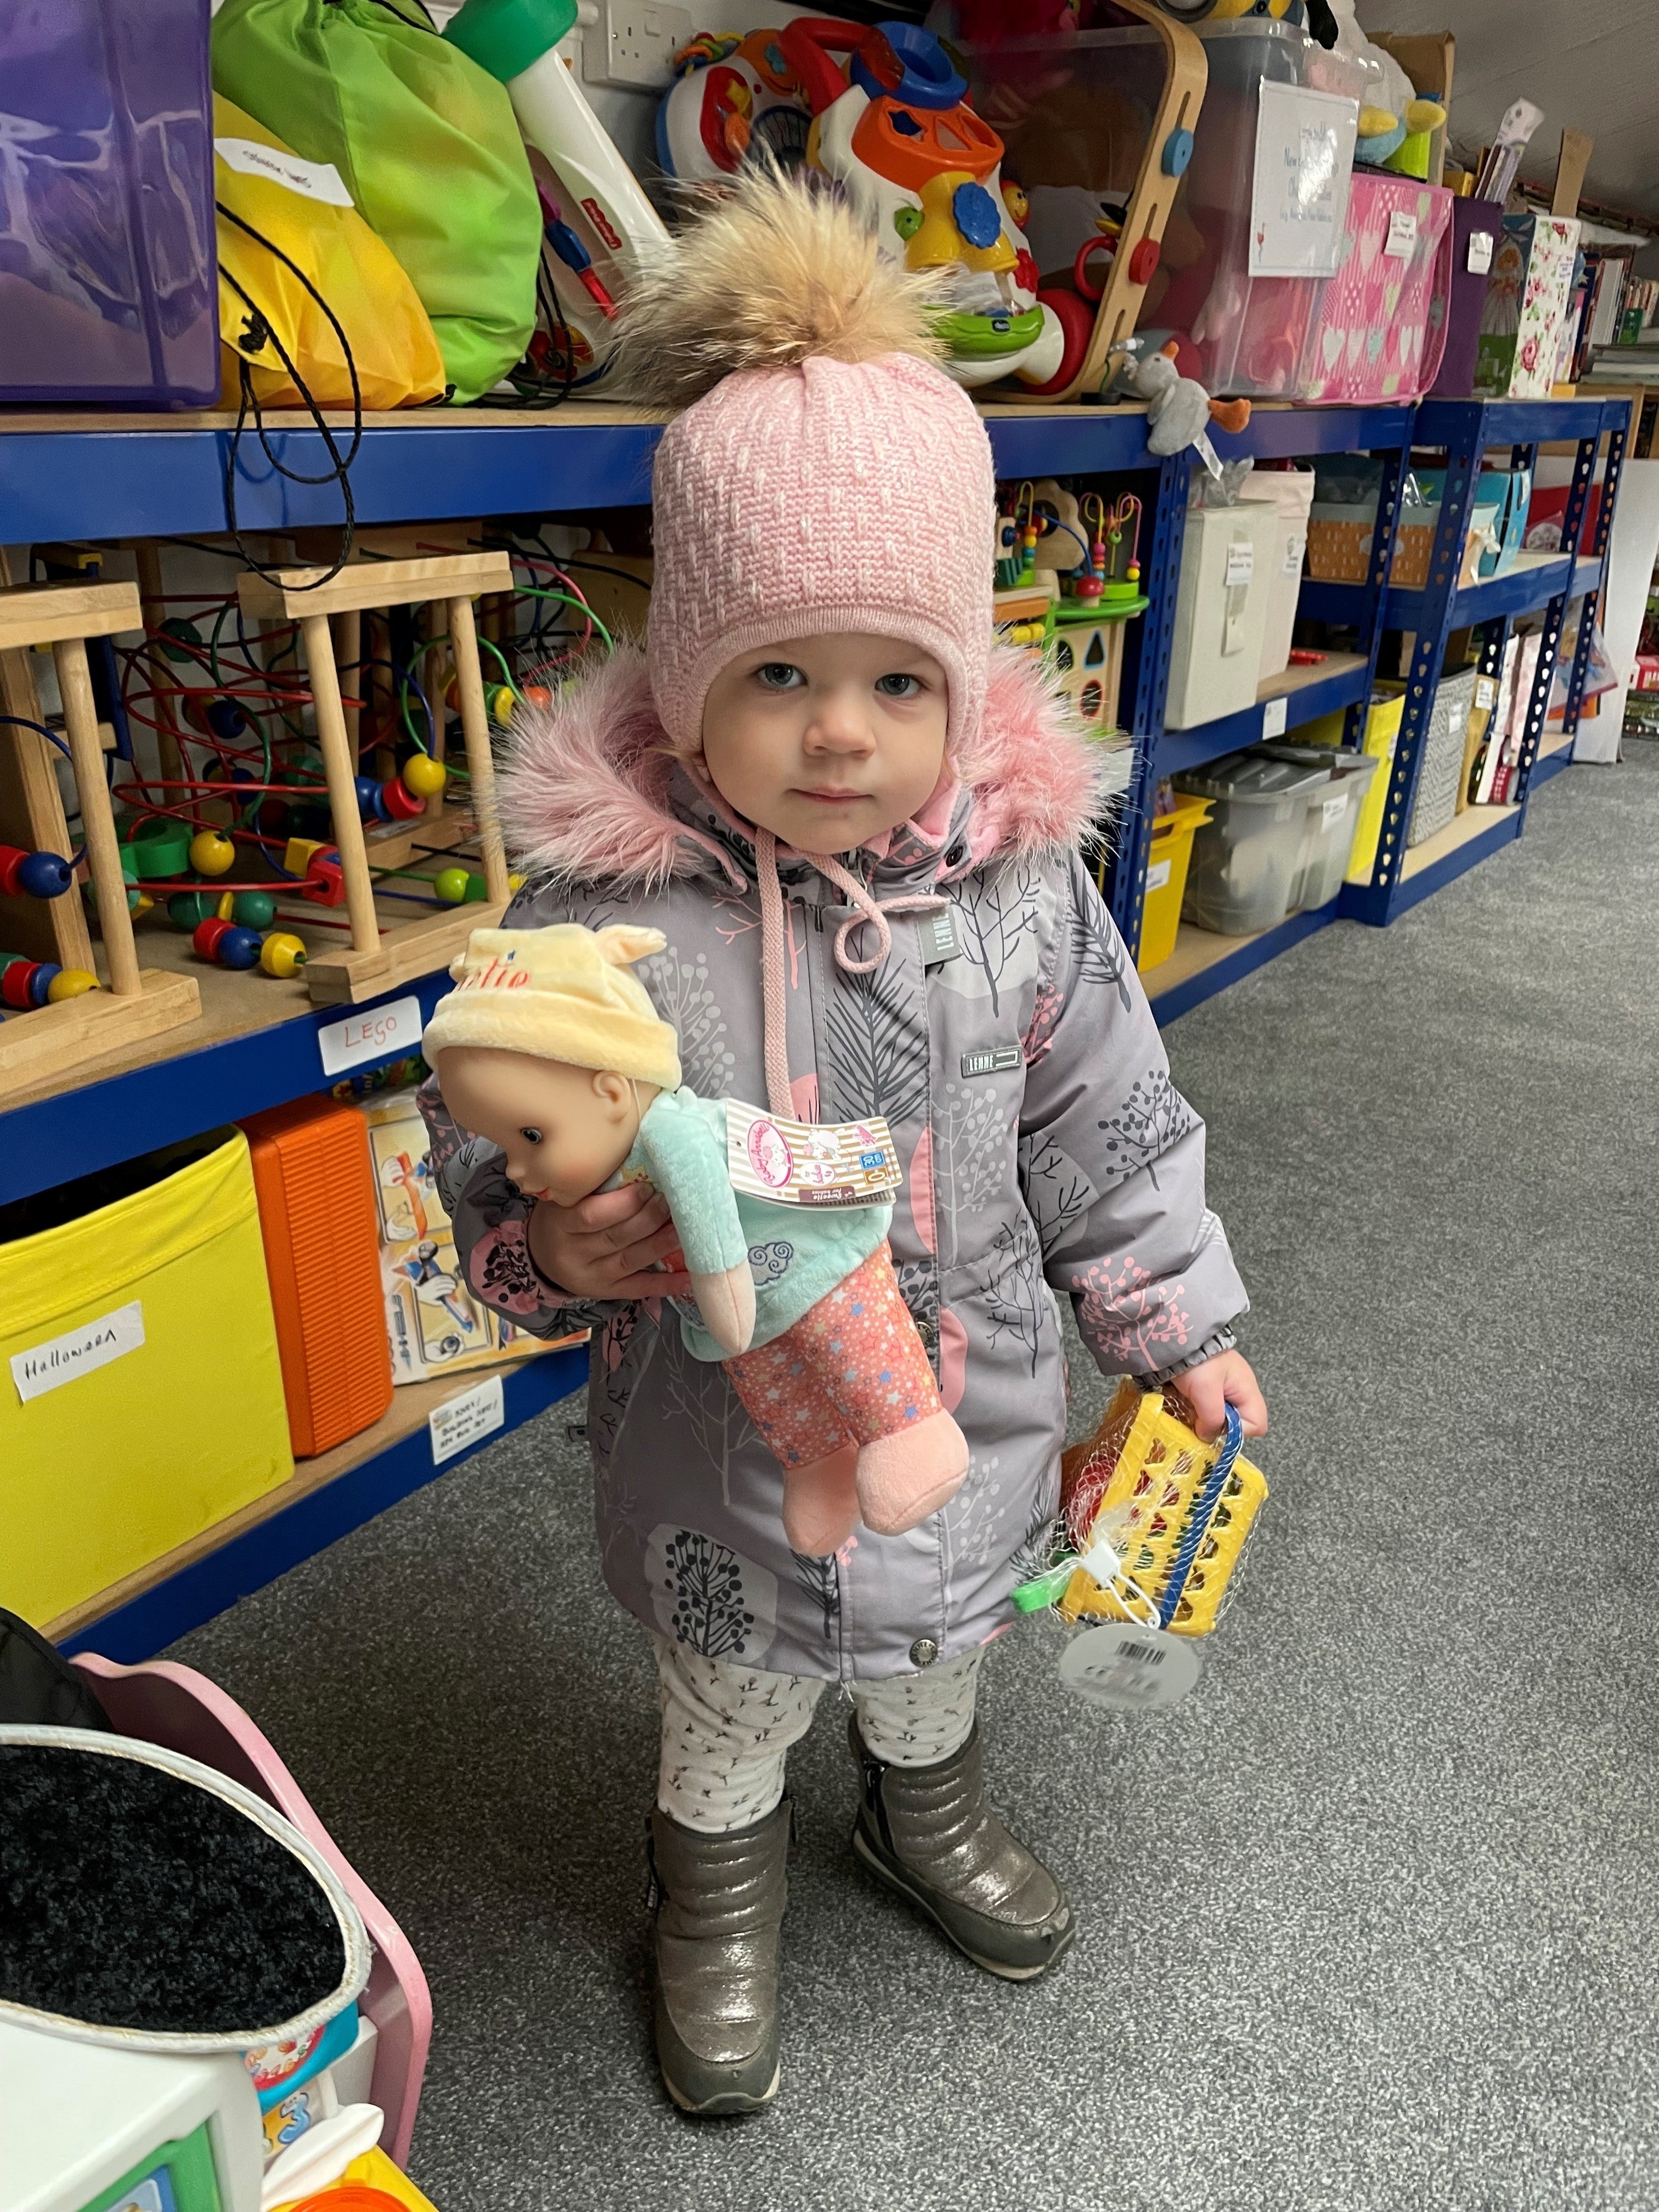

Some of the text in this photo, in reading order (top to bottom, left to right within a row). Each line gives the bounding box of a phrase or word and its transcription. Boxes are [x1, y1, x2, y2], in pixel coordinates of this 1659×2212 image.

[969, 1054, 994, 1071] LENNE
[756, 1158, 776, 1184] Baby
[863, 1155, 876, 1166] 30
[25, 1329, 116, 1380] Halloween
[279, 2092, 311, 2145] 3
